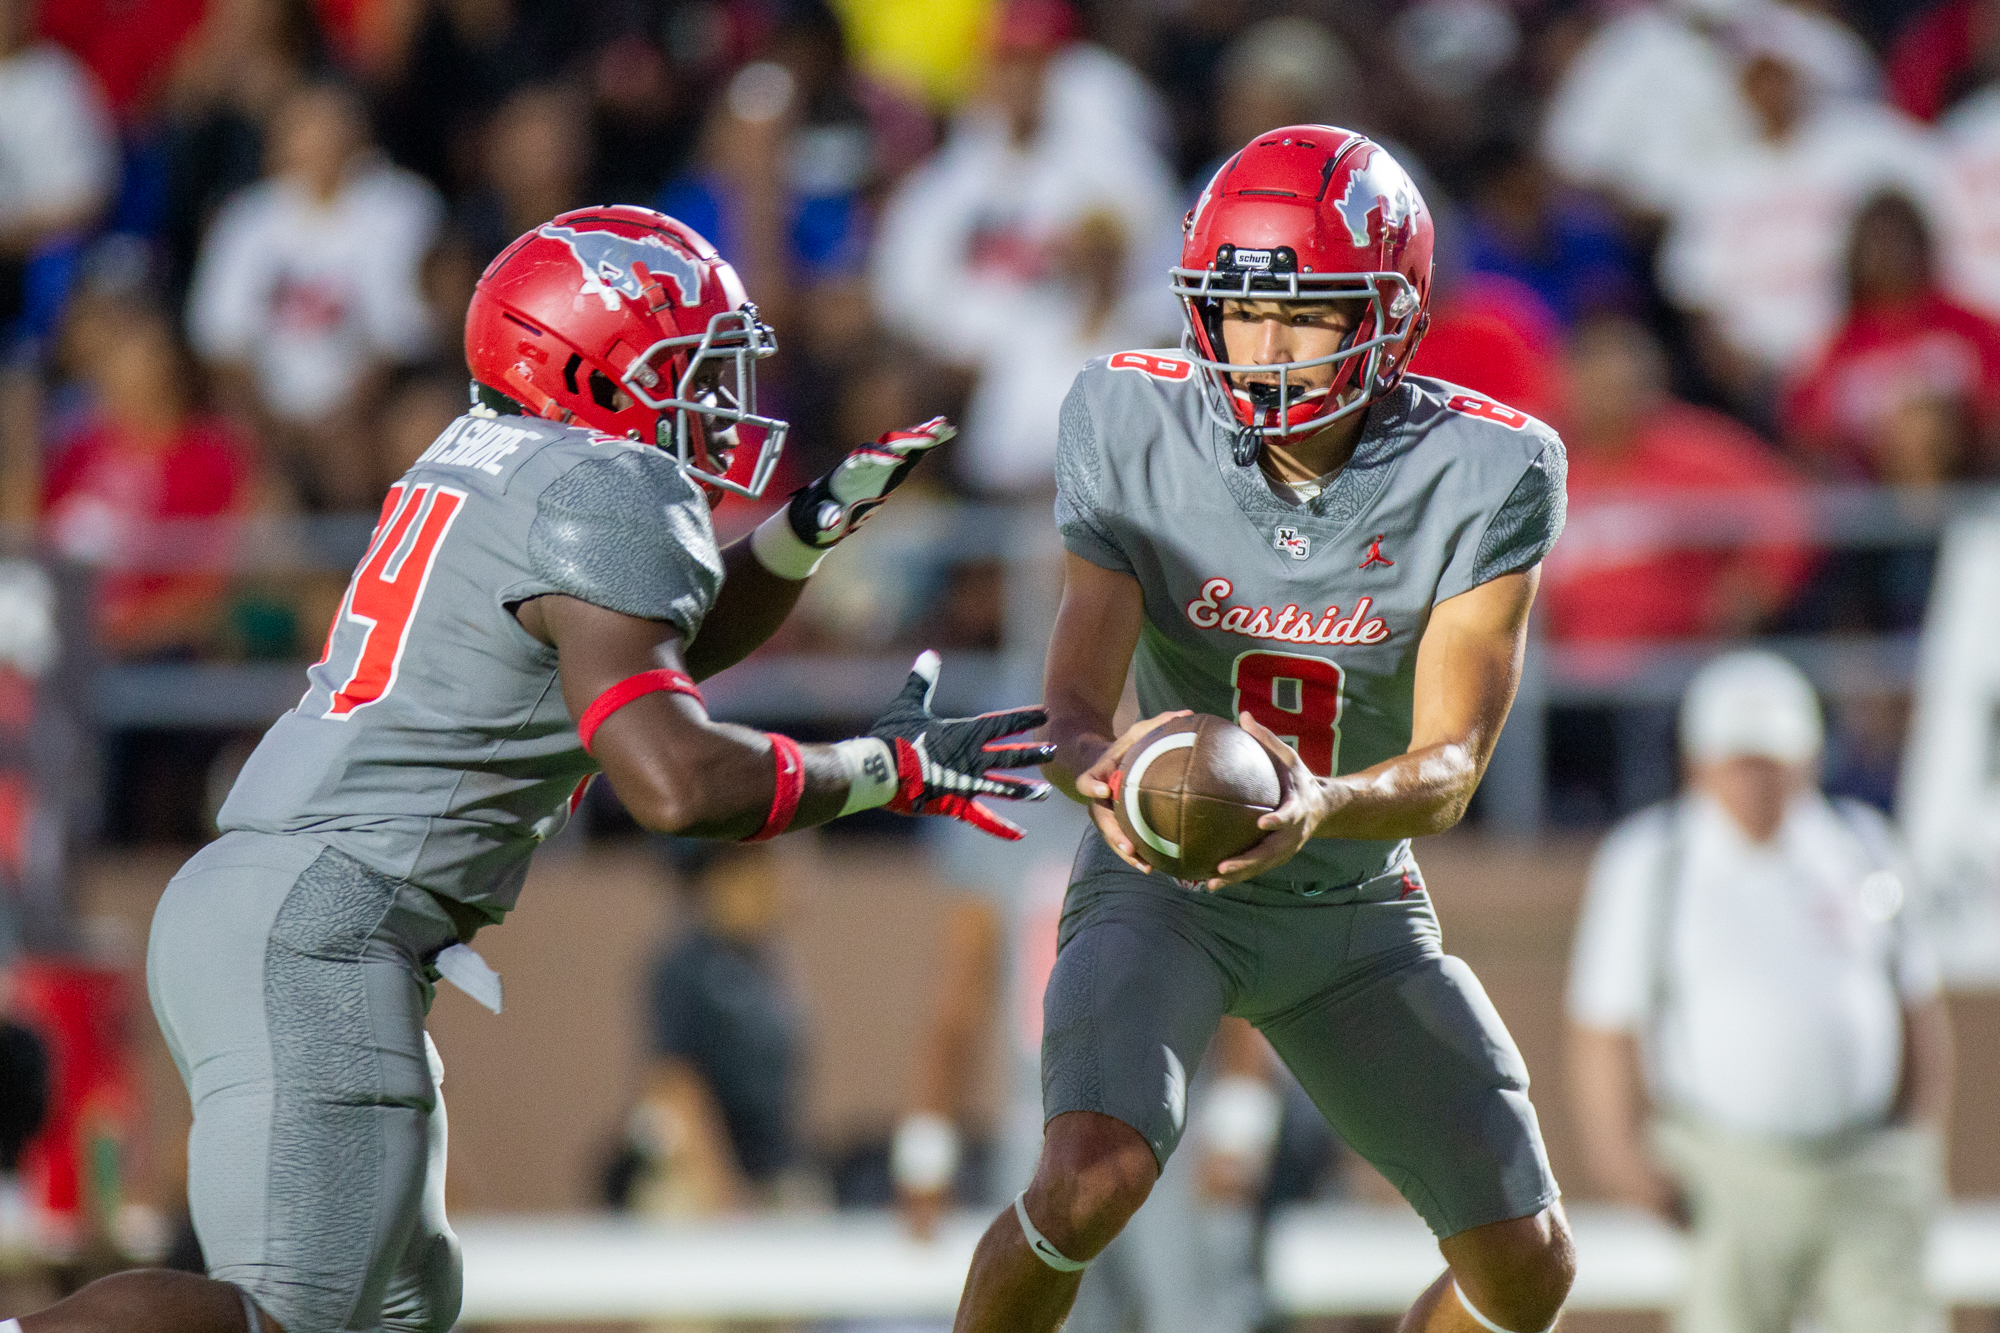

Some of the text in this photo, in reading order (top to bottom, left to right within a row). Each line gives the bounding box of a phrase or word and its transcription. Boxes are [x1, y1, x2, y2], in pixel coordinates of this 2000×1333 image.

[1239, 254, 1270, 263] schutt
[1107, 351, 1196, 383] 8
[1444, 393, 1531, 432] 8
[433, 419, 544, 476] SHORE
[1186, 577, 1390, 646] Eastside
